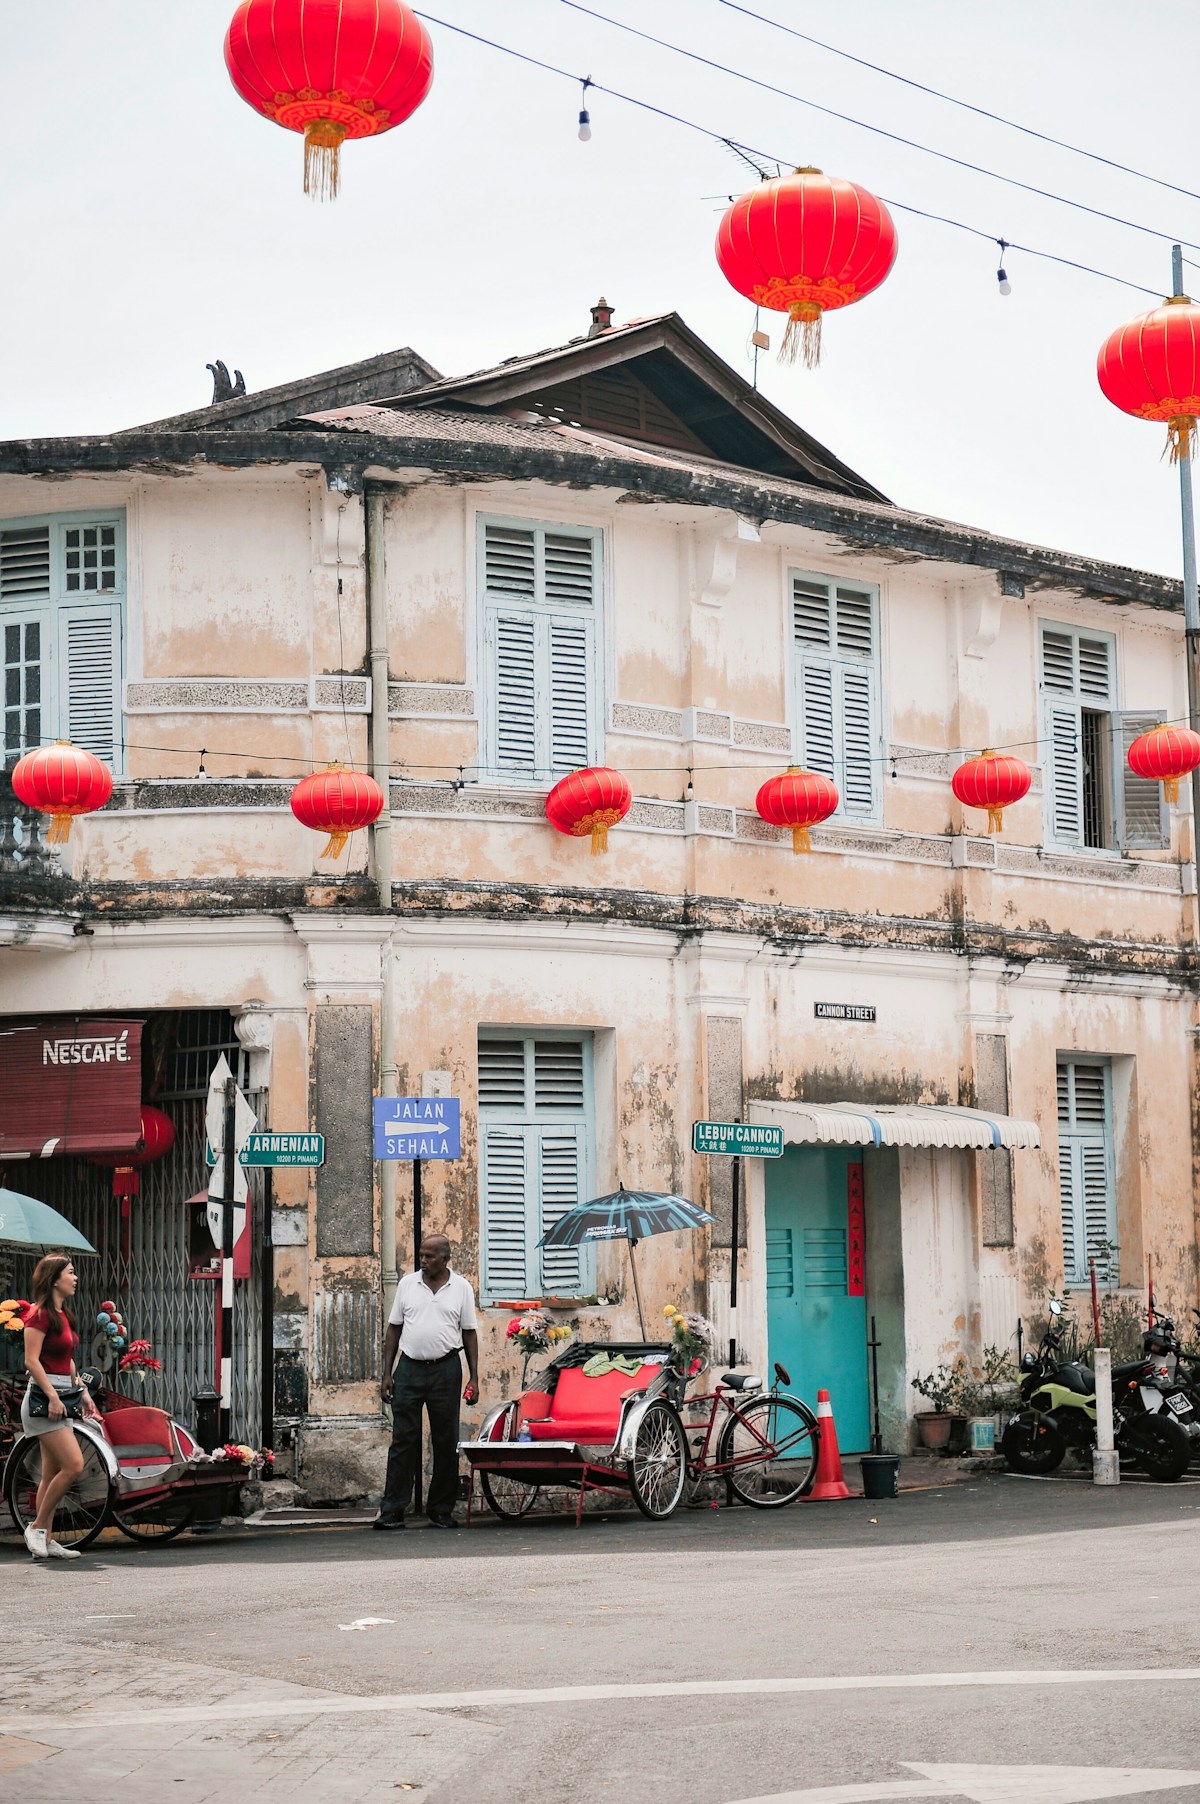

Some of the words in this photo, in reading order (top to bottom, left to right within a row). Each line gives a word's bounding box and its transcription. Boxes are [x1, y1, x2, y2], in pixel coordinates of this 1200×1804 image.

[817, 1004, 845, 1017] CANNON
[846, 1006, 873, 1019] STREET
[393, 1103, 444, 1118] JALAN
[699, 1125, 734, 1141] LEBUH
[736, 1127, 779, 1144] CANNON
[253, 1137, 319, 1152] ARMENIAN
[387, 1139, 449, 1154] SEHALA
[741, 1145, 754, 1153] 10200
[760, 1146, 779, 1154] PINANG
